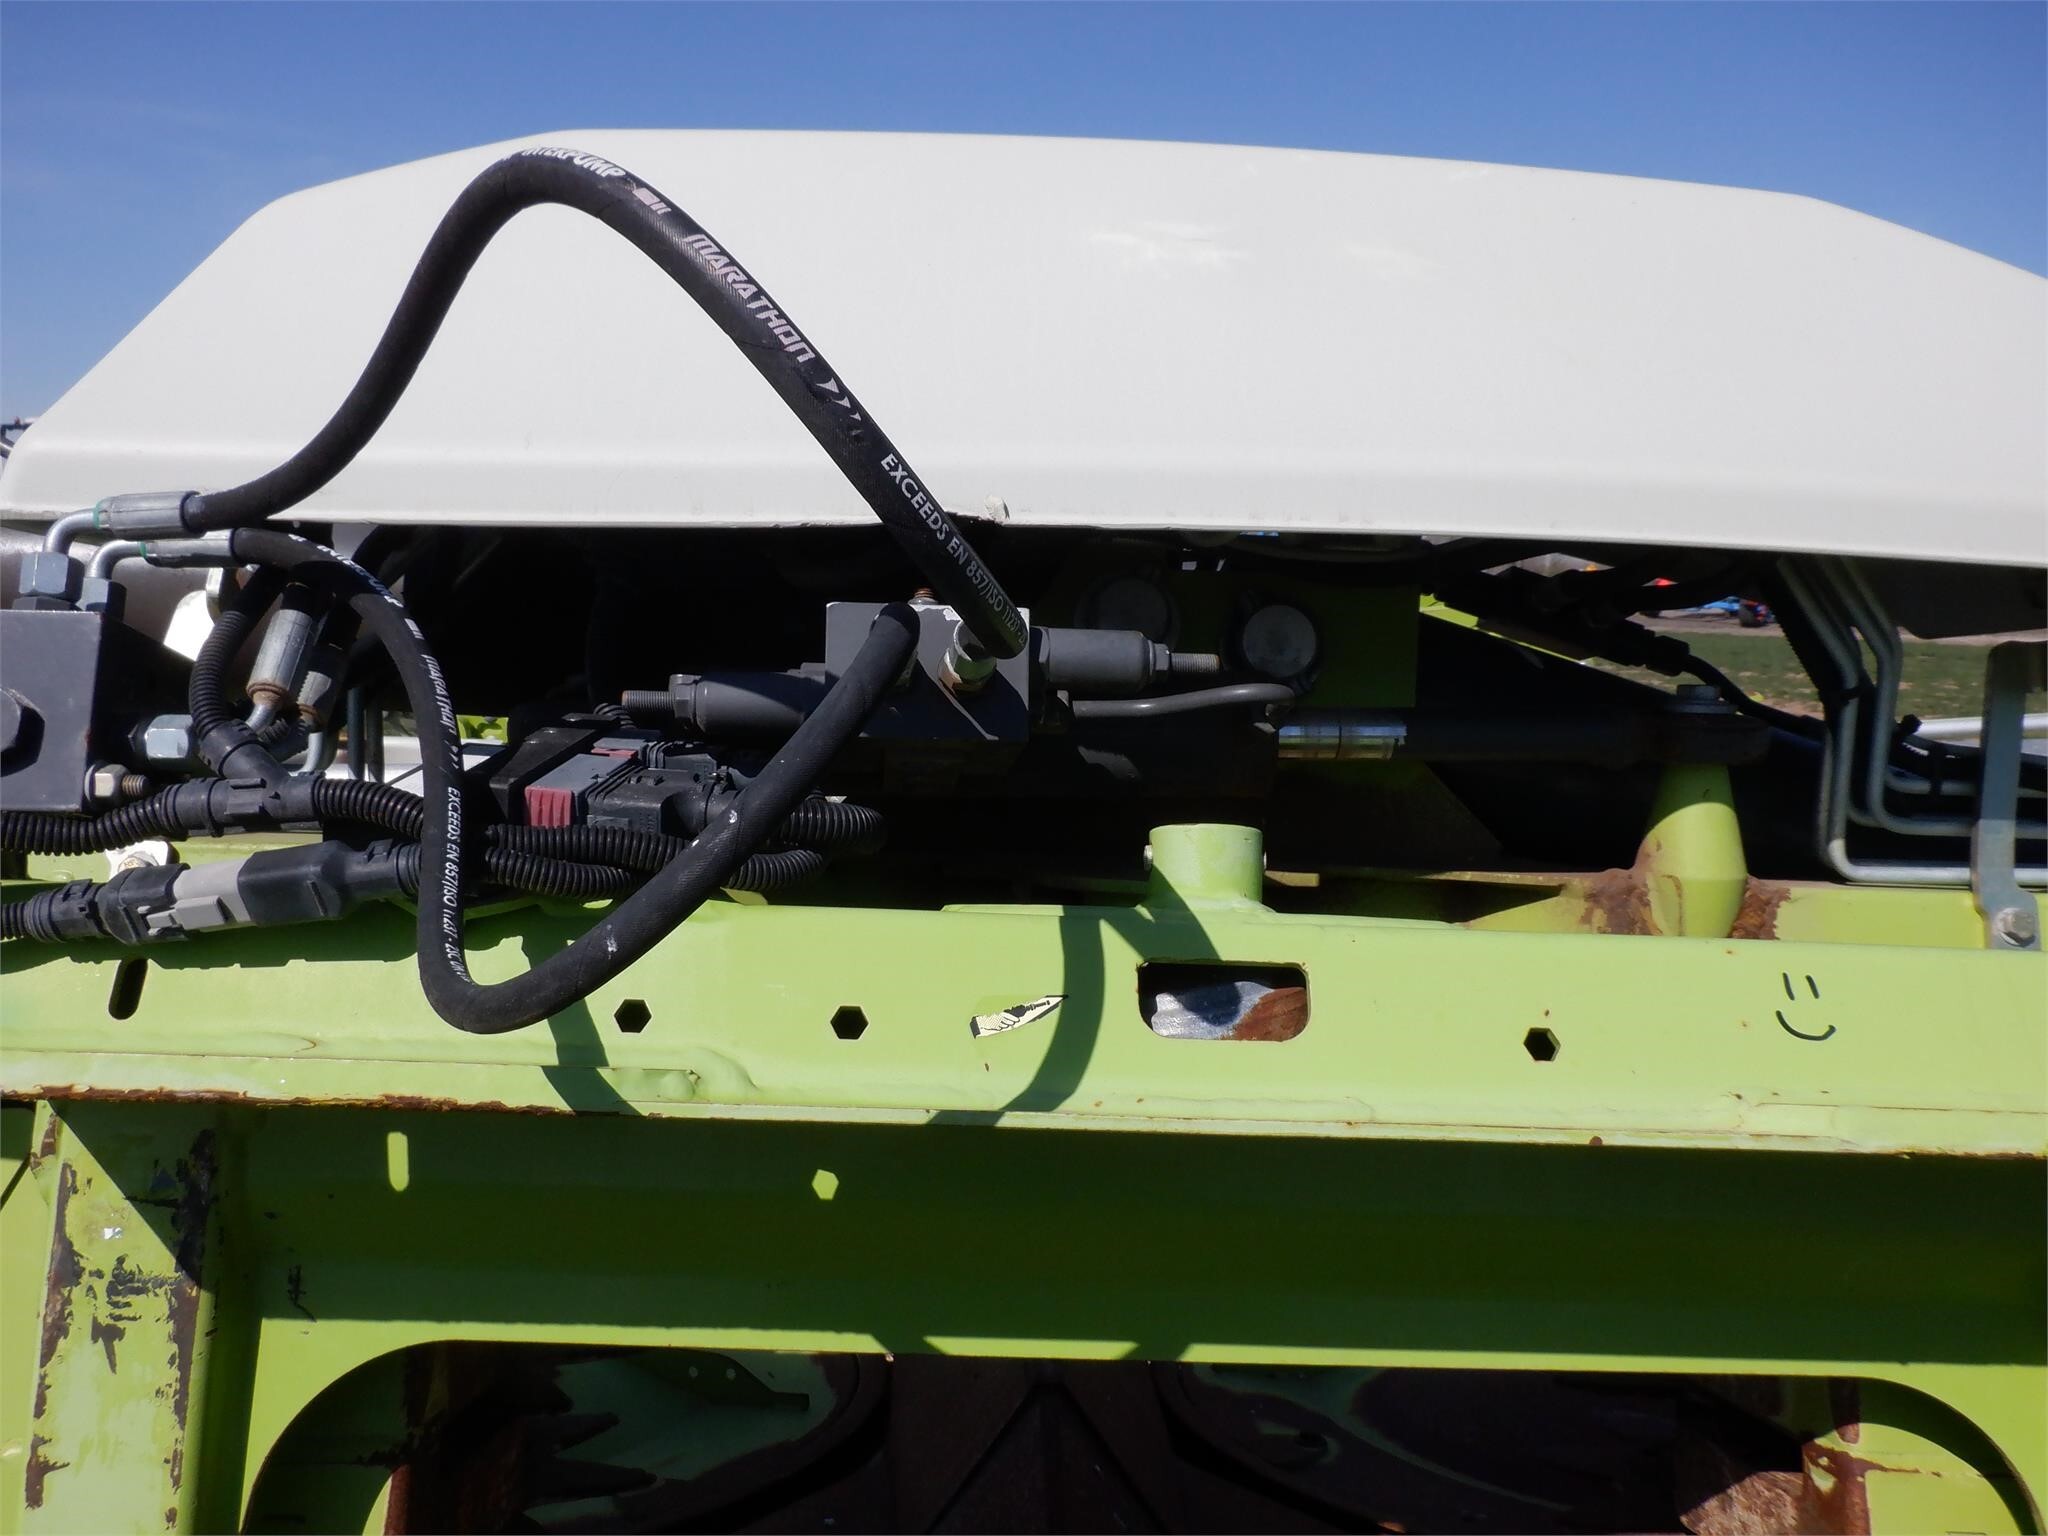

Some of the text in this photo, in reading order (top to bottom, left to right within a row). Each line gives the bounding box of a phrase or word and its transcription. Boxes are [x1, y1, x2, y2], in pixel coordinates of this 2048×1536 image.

[683, 234, 815, 363] MARATHON
[881, 453, 949, 540] EXCEEDS
[947, 537, 968, 566] EN
[966, 561, 1004, 611] 857/ISO
[447, 787, 462, 842] EXCEEDS
[446, 843, 460, 862] EN
[441, 862, 459, 907] 857/ISO
